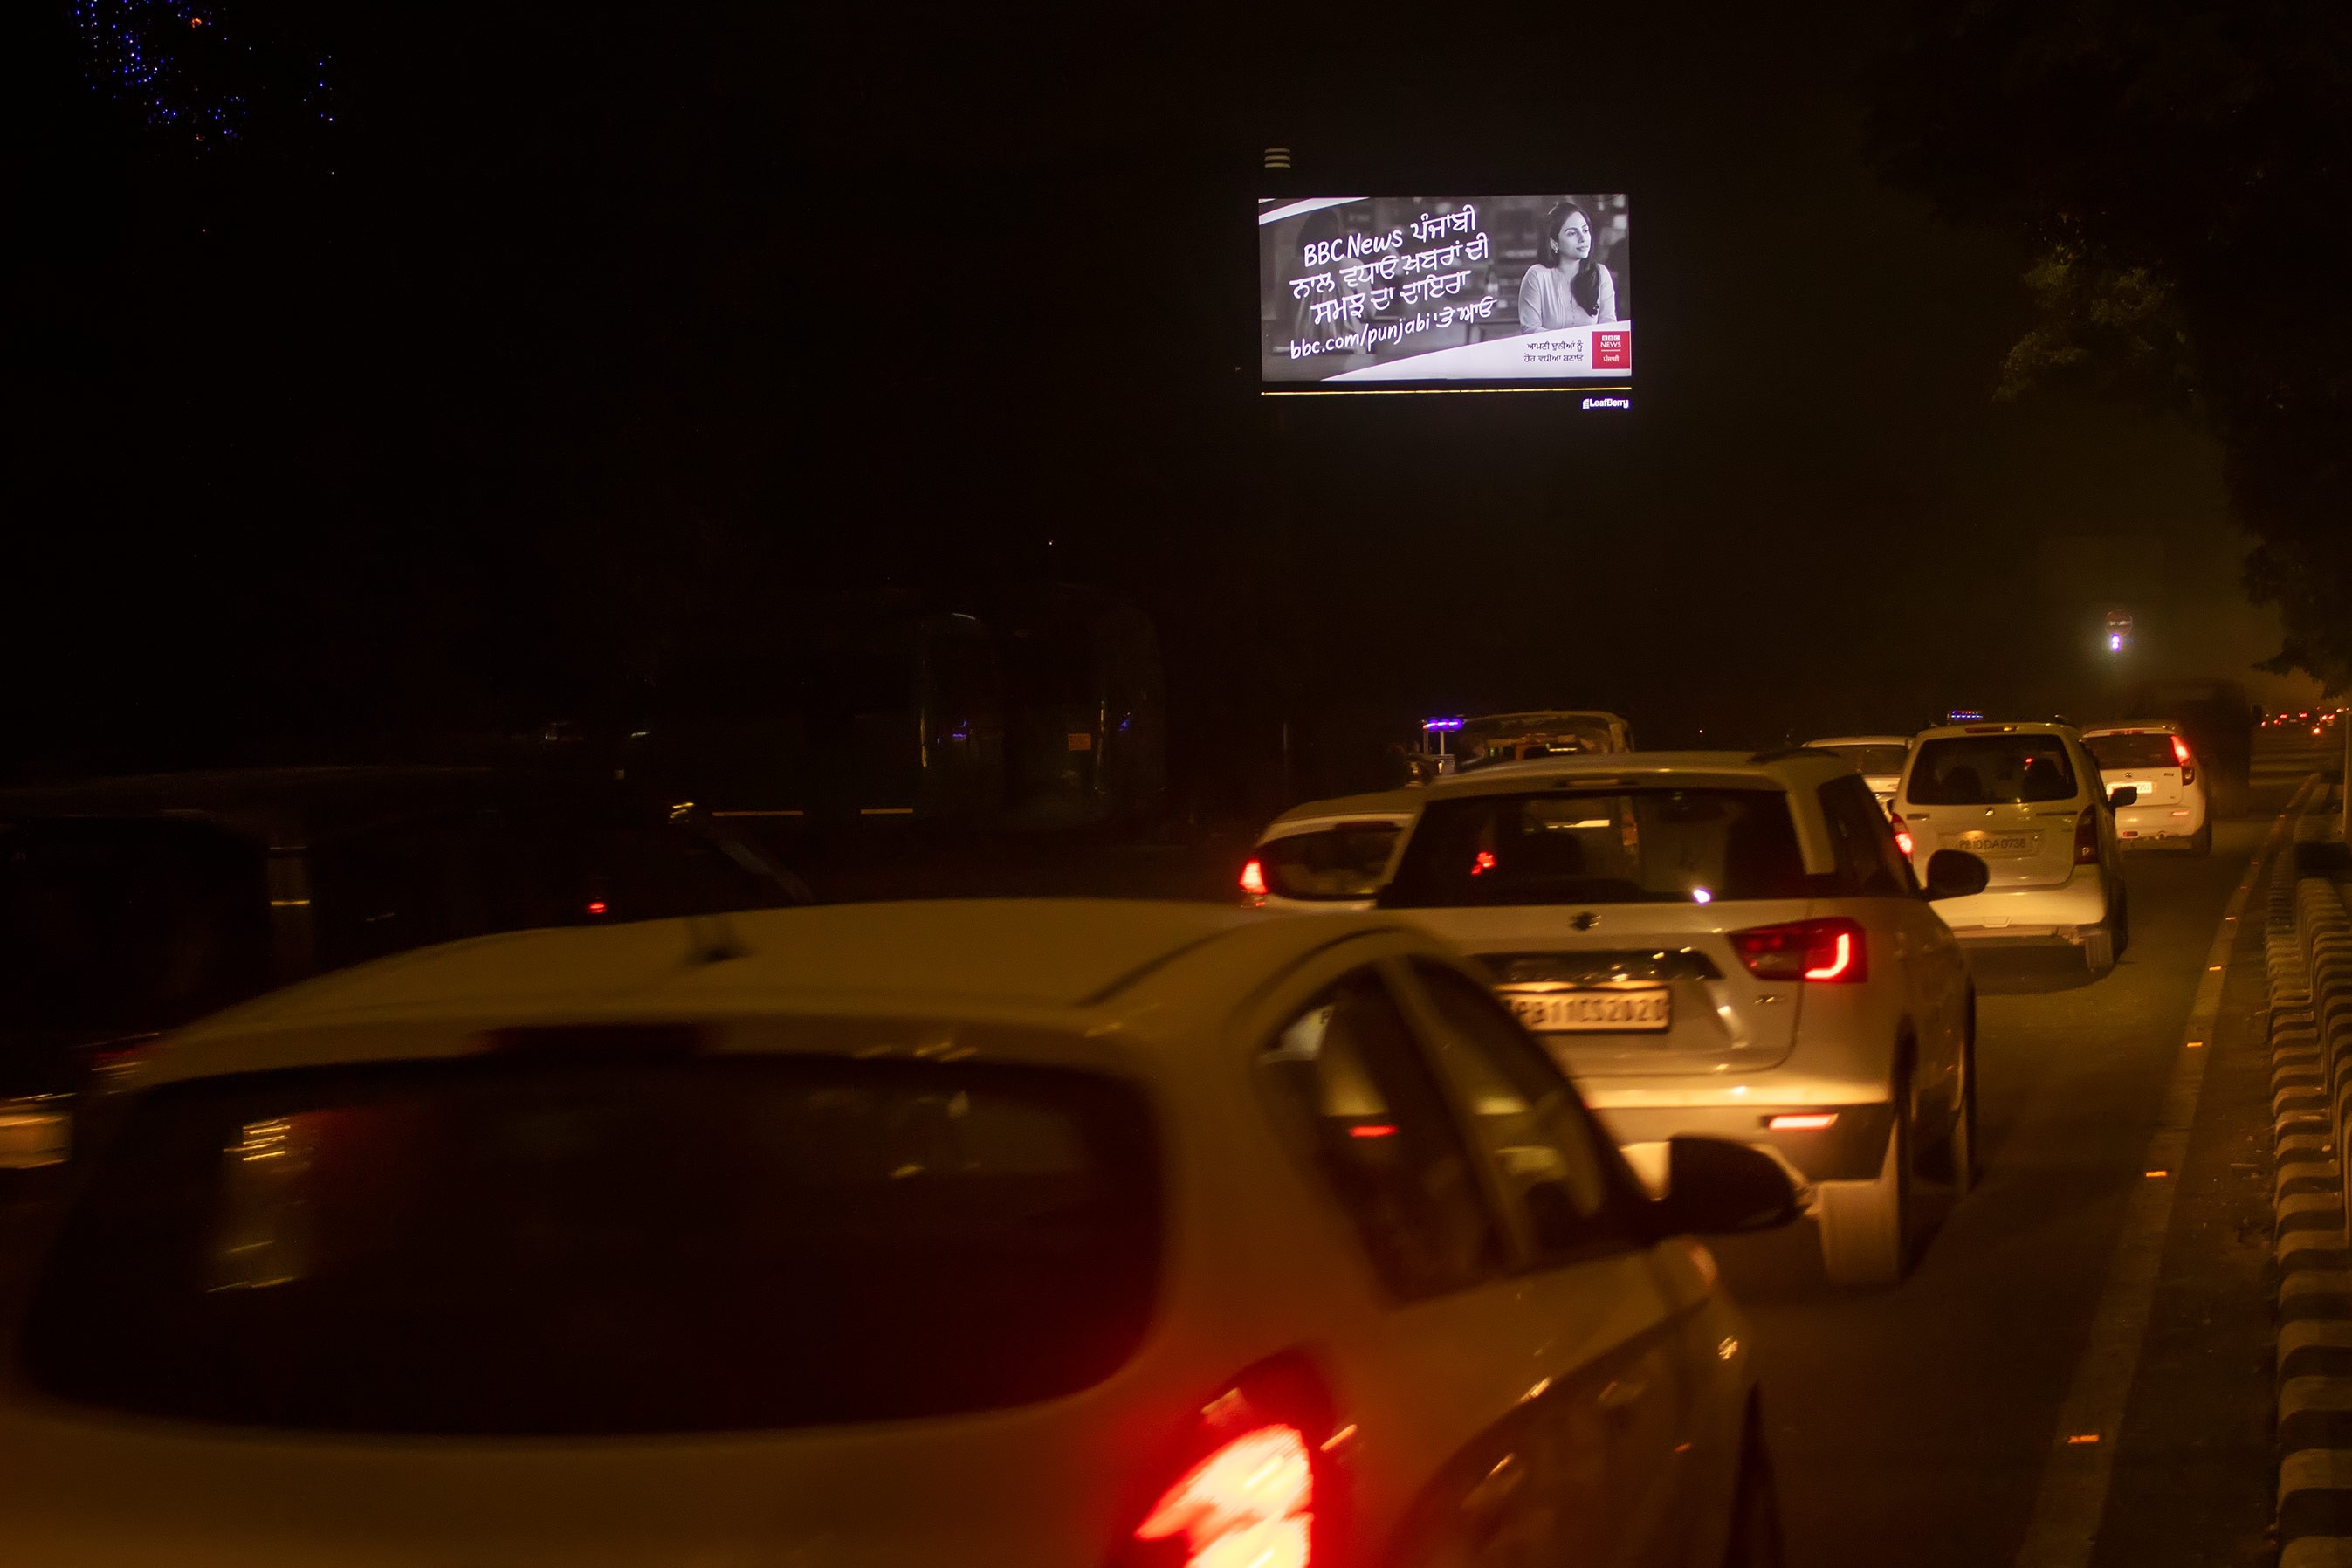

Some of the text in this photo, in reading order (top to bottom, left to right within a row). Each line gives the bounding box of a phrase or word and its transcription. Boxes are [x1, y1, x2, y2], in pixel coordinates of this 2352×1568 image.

[1289, 272, 1336, 299] ਨਾਲ
[1339, 255, 1399, 287] ਵਧਾਓ
[1461, 232, 1489, 261] ਦੀ
[1304, 204, 1475, 267] BBC News ਪੰਜਾਬੀ
[1290, 313, 1429, 359] bbc.com/punjabi
[1457, 296, 1498, 324] ਆਓ
[1310, 270, 1471, 325] ਸਮਝ ਦਾ ਦਾਇਰਾ
